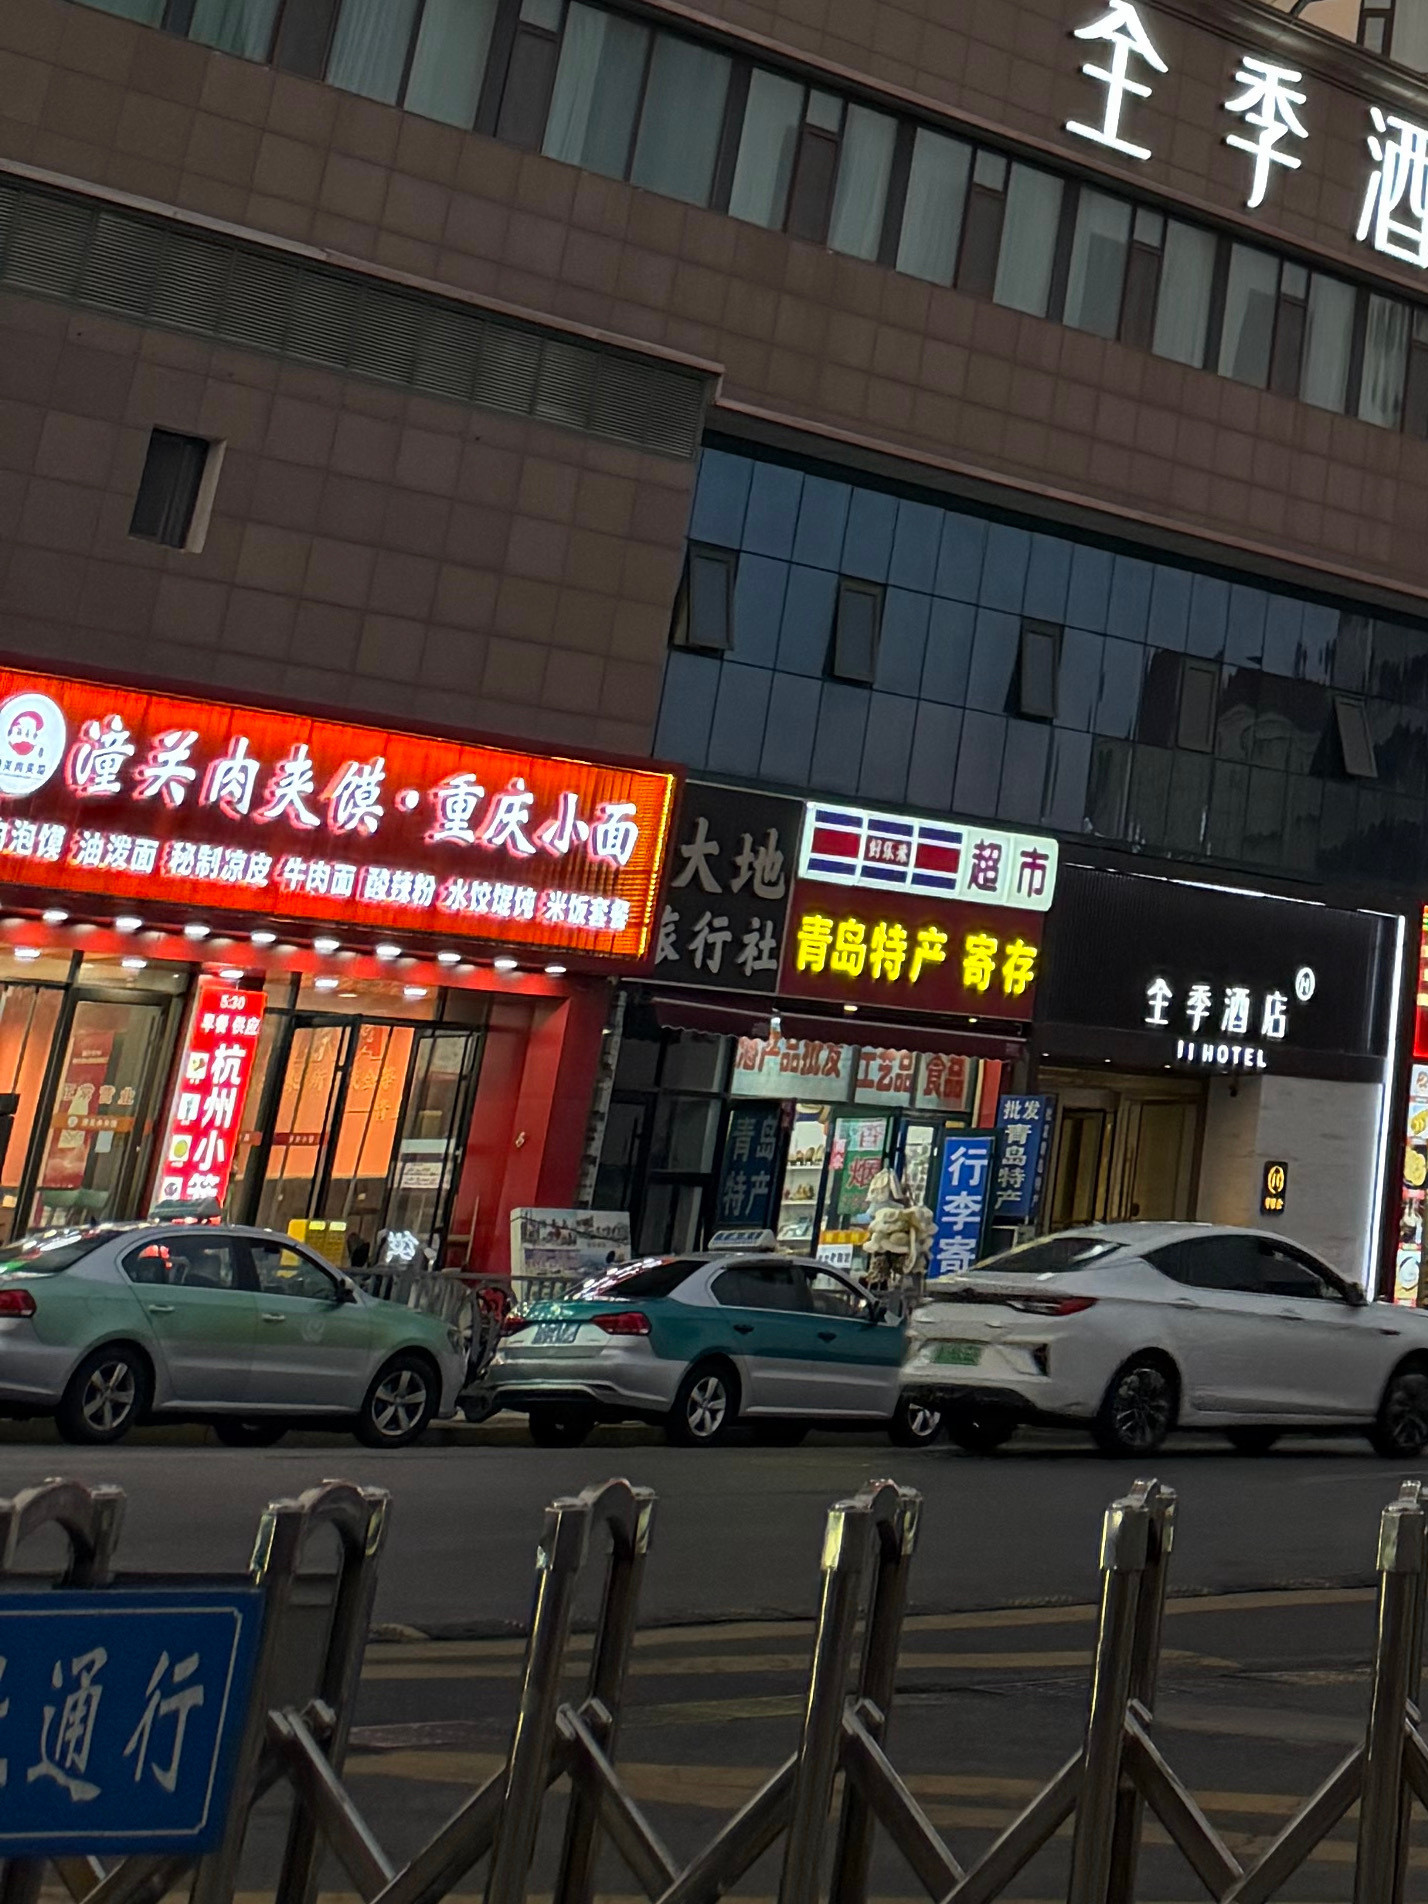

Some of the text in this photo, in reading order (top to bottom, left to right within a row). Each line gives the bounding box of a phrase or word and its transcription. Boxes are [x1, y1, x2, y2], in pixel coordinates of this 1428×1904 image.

[76, 829, 160, 875] 油泼面
[168, 840, 274, 888] 秘制凉皮
[282, 856, 357, 898] 牛肉面
[672, 816, 786, 900] 大地
[966, 838, 1050, 898] 超市
[797, 913, 1039, 997] 青岛特产 寄存
[1144, 978, 1288, 1039] 全季酒店
[923, 1054, 966, 1098] 食品
[1202, 1044, 1267, 1068] HOTEL
[733, 1117, 777, 1162] 青岛
[1003, 1100, 1041, 1120] 批发
[723, 1170, 771, 1217] 特产
[994, 1123, 1033, 1210] 青岛特产
[936, 1146, 989, 1275] 行李寄
[0, 1646, 204, 1803] 通行
